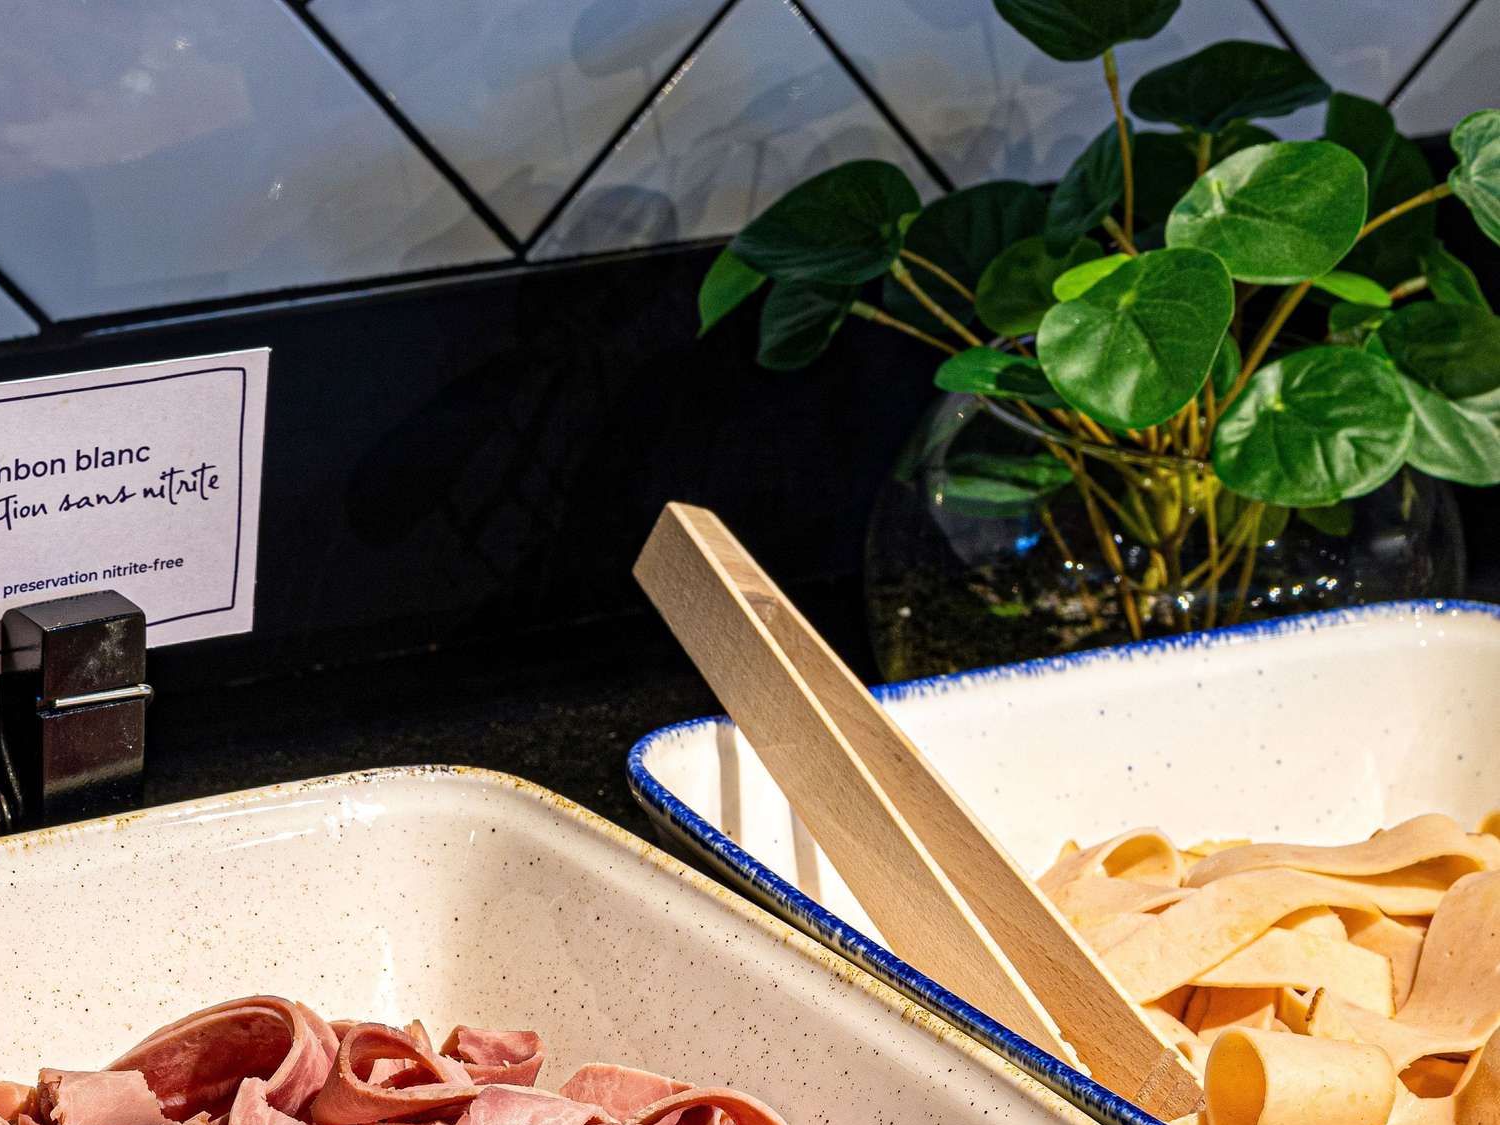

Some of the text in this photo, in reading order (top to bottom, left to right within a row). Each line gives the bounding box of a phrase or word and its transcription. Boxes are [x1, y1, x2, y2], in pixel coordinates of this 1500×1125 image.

[75, 446, 151, 472] blanc
[58, 485, 137, 512] sans
[142, 462, 220, 506] nitrite
[3, 571, 98, 599] preservation
[102, 557, 184, 580] nitrite-free
